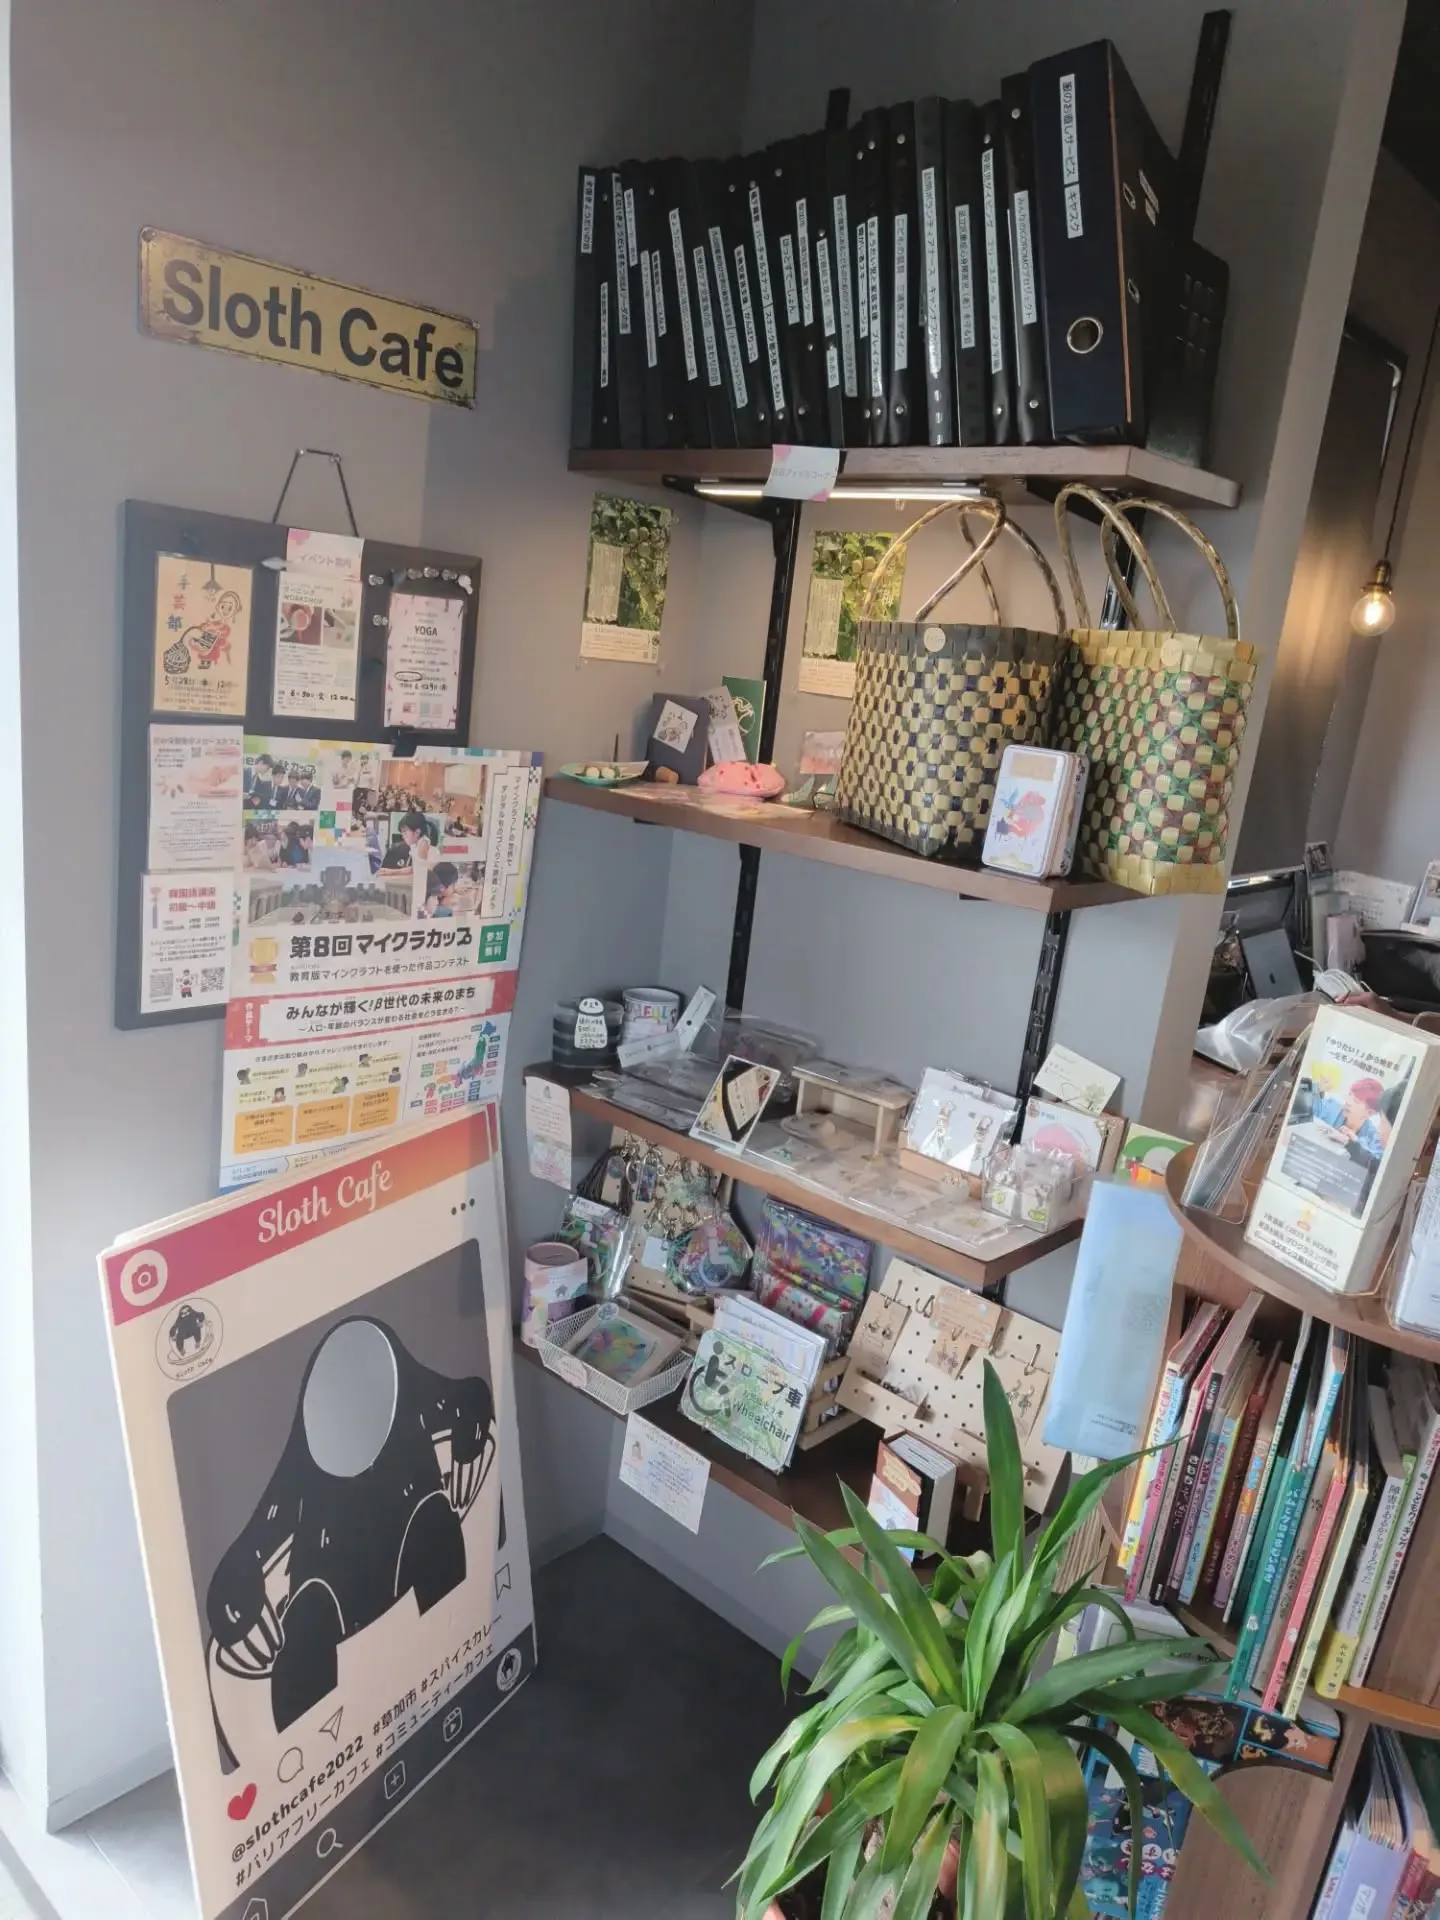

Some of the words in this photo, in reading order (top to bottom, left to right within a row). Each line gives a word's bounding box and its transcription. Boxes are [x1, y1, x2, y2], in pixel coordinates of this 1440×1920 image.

[162, 259, 322, 356] Sloth
[339, 307, 464, 388] Cafe
[414, 625, 438, 637] YOGA
[258, 1186, 332, 1243] Sloth
[337, 1160, 393, 1212] Cafe
[724, 1353, 804, 1411] スロープ車
[732, 1398, 792, 1444] Wheelchair
[232, 1735, 364, 1863] @slothcafe2022
[373, 1688, 417, 1736] #草加市
[420, 1614, 502, 1693] #スパイスカレー
[235, 1758, 370, 1887] #バリアフリーカフェ
[376, 1644, 494, 1759] #コミュニティーカフェ
